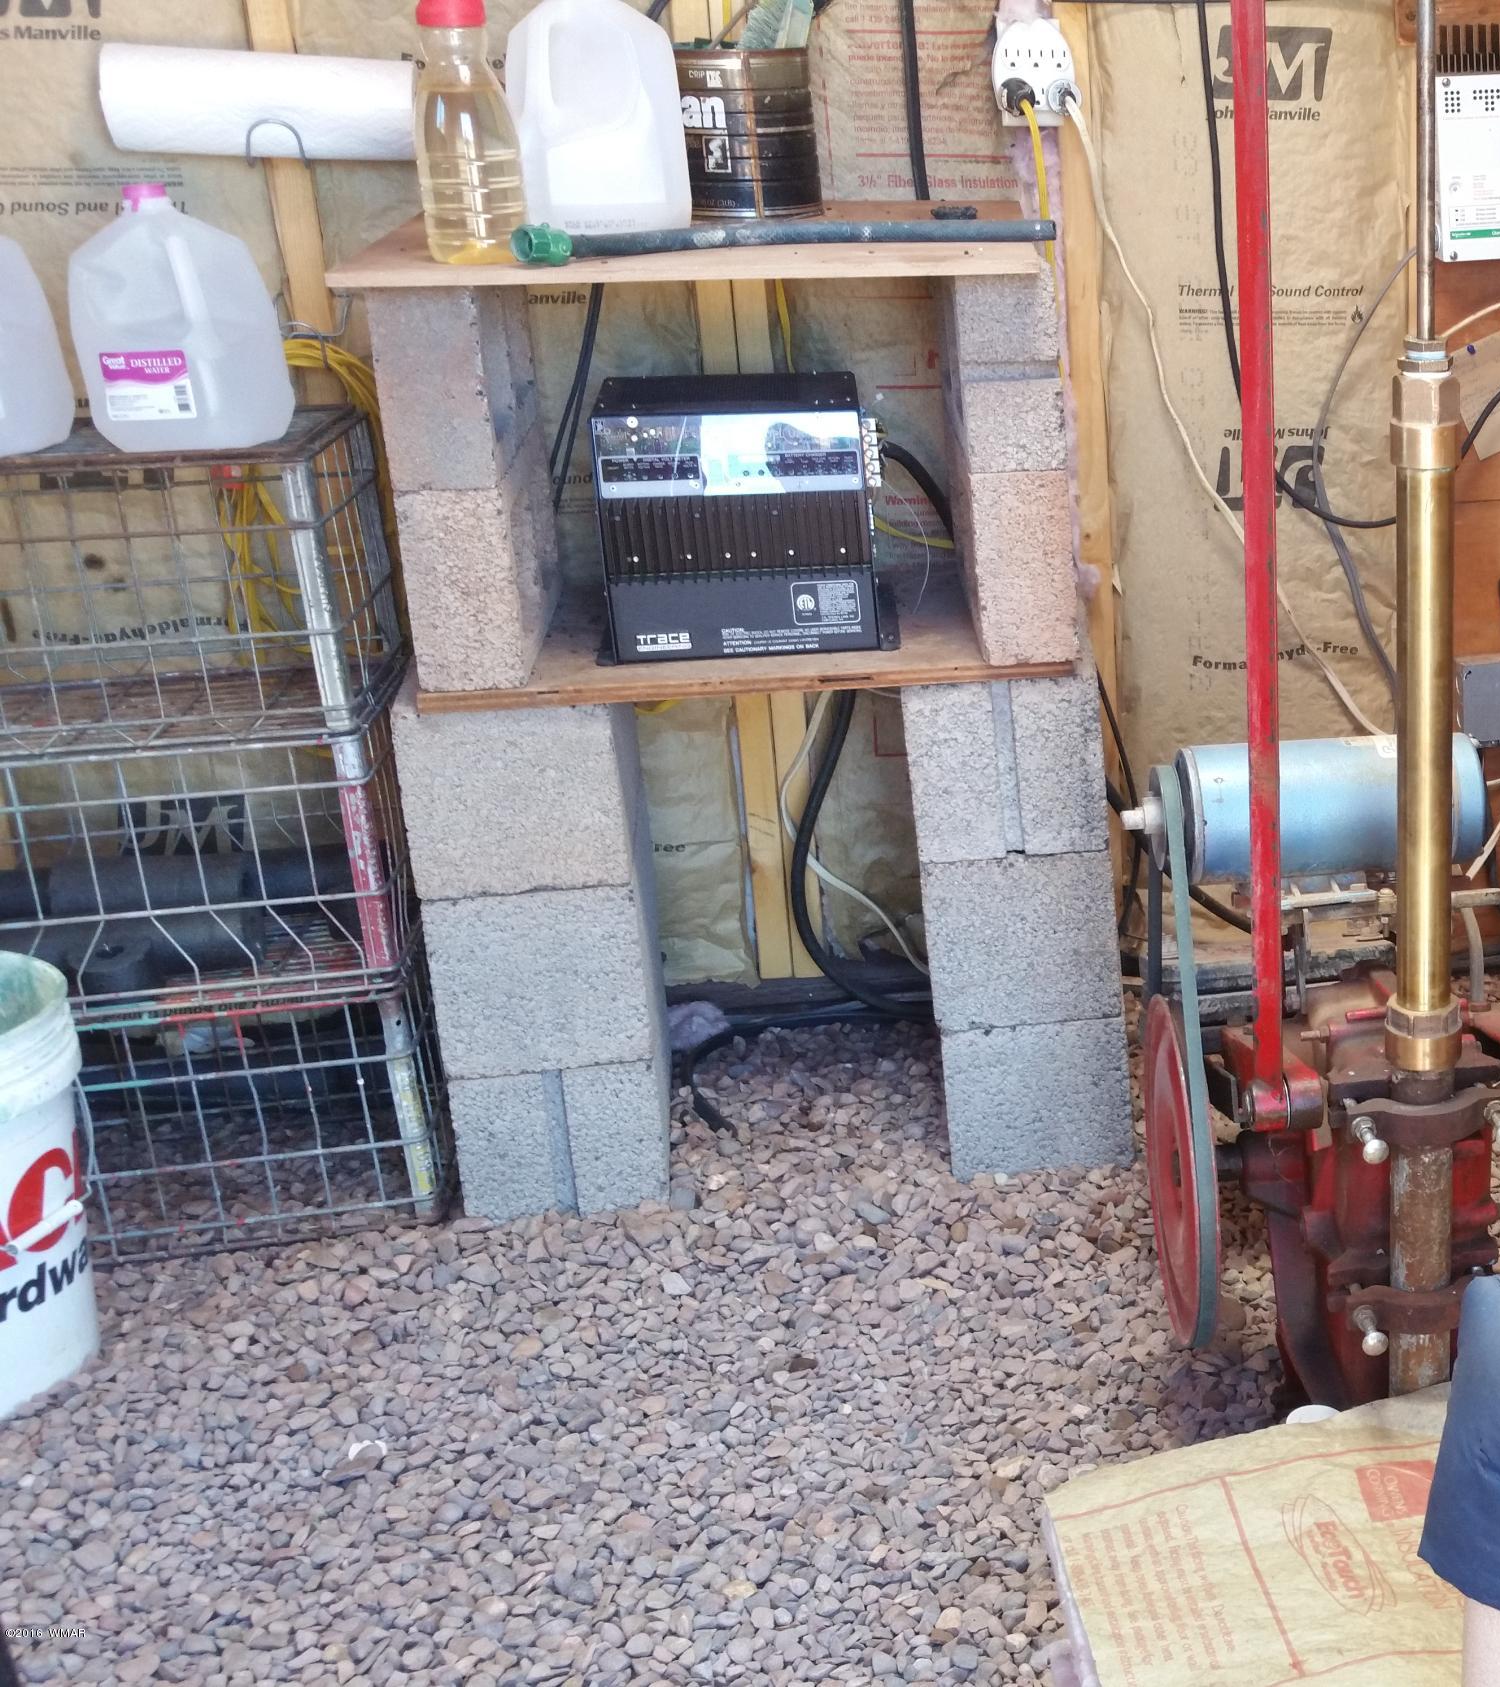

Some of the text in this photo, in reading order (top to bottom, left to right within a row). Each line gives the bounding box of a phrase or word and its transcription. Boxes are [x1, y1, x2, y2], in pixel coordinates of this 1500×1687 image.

[14, 25, 101, 41] Manville
[1266, 107, 1320, 121] anville
[888, 175, 914, 188] Fibe
[961, 174, 1018, 188] Insulation
[1178, 284, 1234, 297] Therml
[1315, 284, 1364, 297] Control
[529, 291, 587, 305] anville
[102, 355, 125, 366] Great
[130, 356, 183, 368] DISTILLED
[144, 366, 171, 375] WATER
[551, 475, 593, 486] ound
[886, 496, 928, 505] Warnin
[1314, 1521, 1366, 1599] EcoTouch
